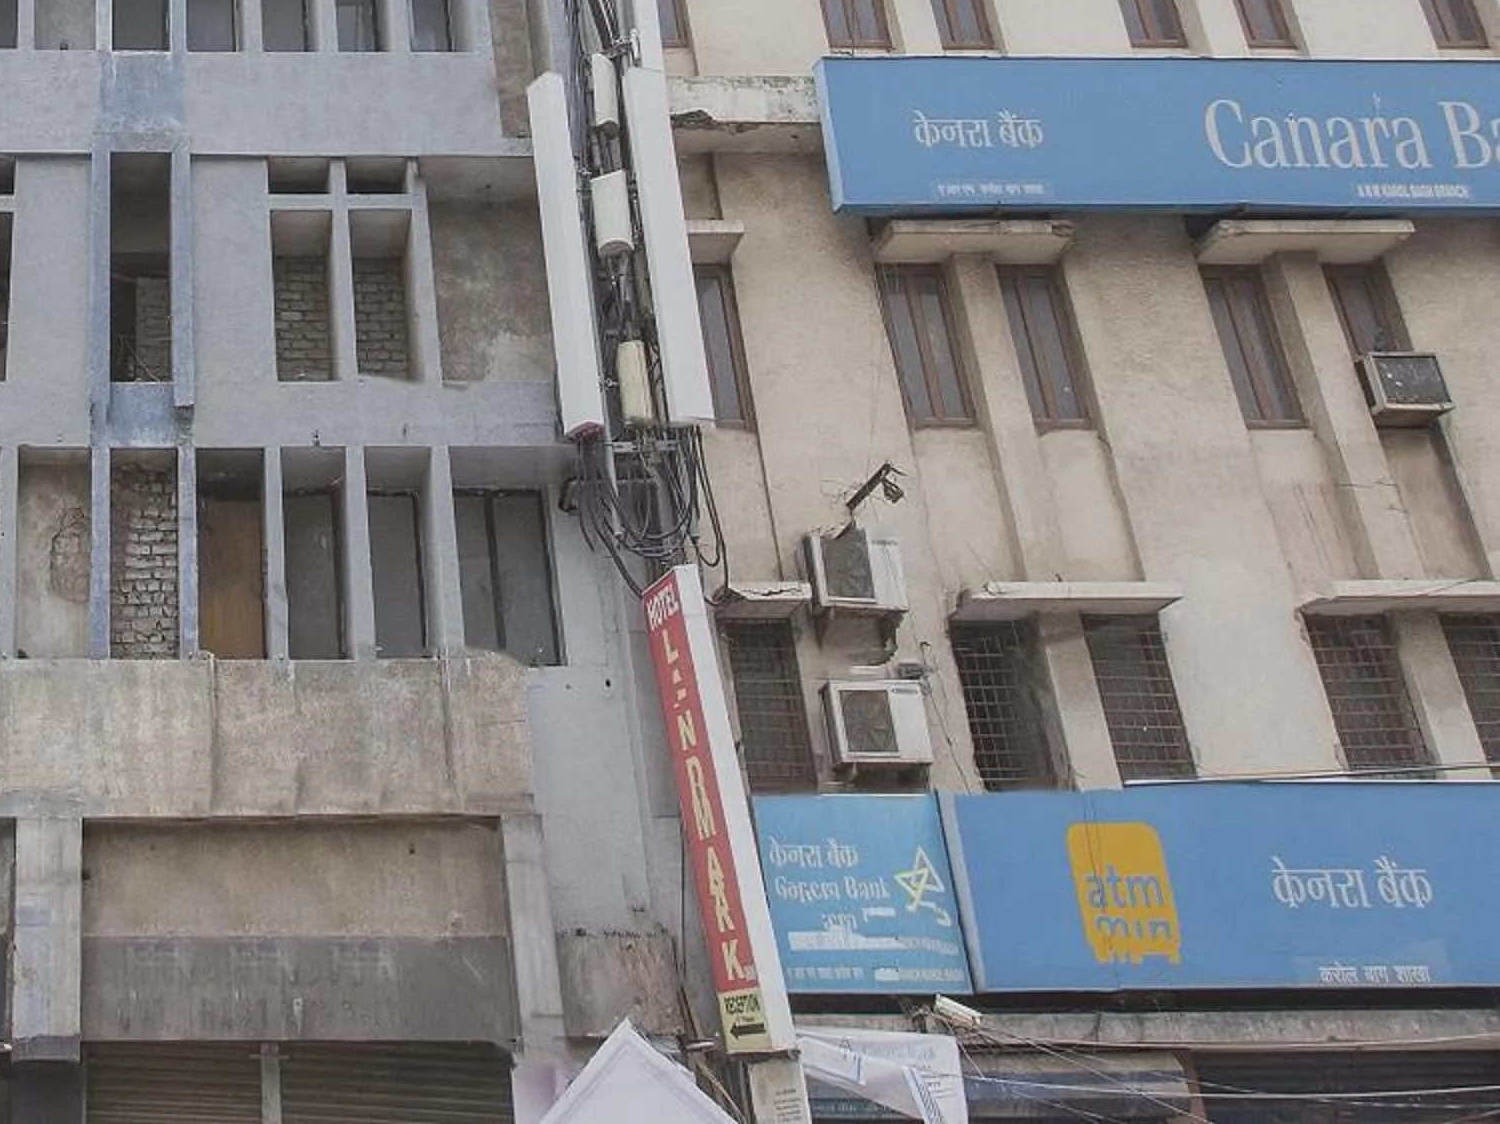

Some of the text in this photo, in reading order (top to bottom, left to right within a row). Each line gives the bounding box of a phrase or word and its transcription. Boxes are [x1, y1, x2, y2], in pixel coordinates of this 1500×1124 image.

[912, 108, 1043, 148] केनरा बैंक
[1205, 99, 1500, 168] Canara Ba
[1085, 865, 1166, 910] atm
[1270, 855, 1433, 908] केनरा बैंक
